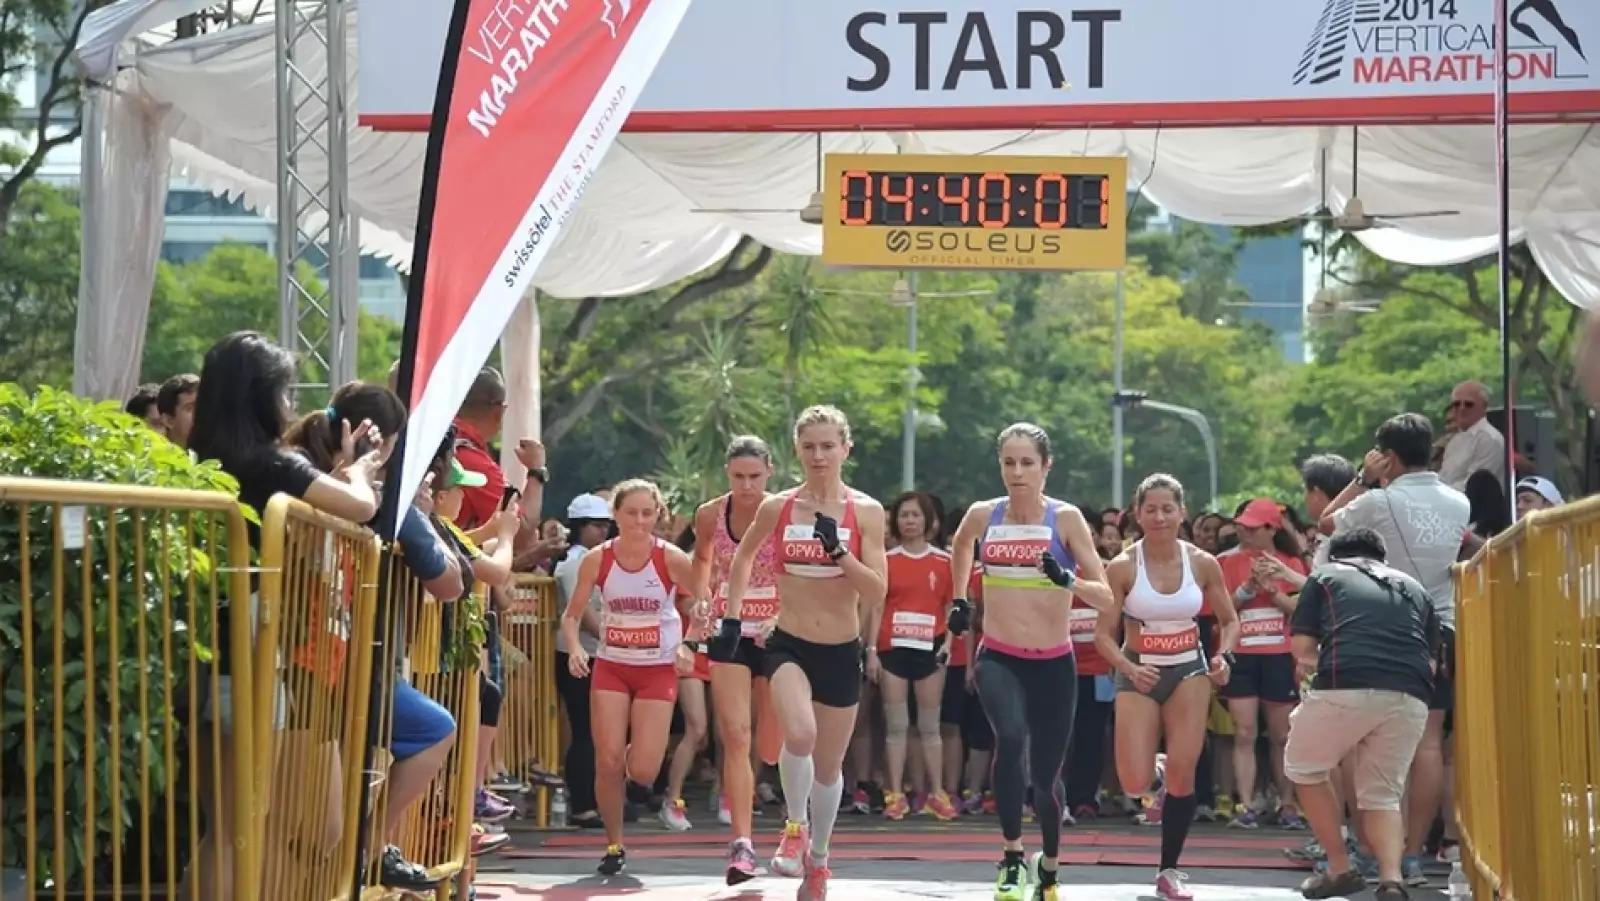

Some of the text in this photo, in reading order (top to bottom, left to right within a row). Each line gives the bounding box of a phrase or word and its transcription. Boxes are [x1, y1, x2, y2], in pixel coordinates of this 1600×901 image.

[468, 0, 531, 64] VER
[1384, 0, 1458, 21] 2014
[846, 9, 1121, 91] START
[1353, 53, 1552, 83] MARATHON
[840, 170, 1109, 229] 04:40:01
[504, 204, 553, 288] swissôtel
[910, 255, 1035, 266] OFFICIAL TIMER
